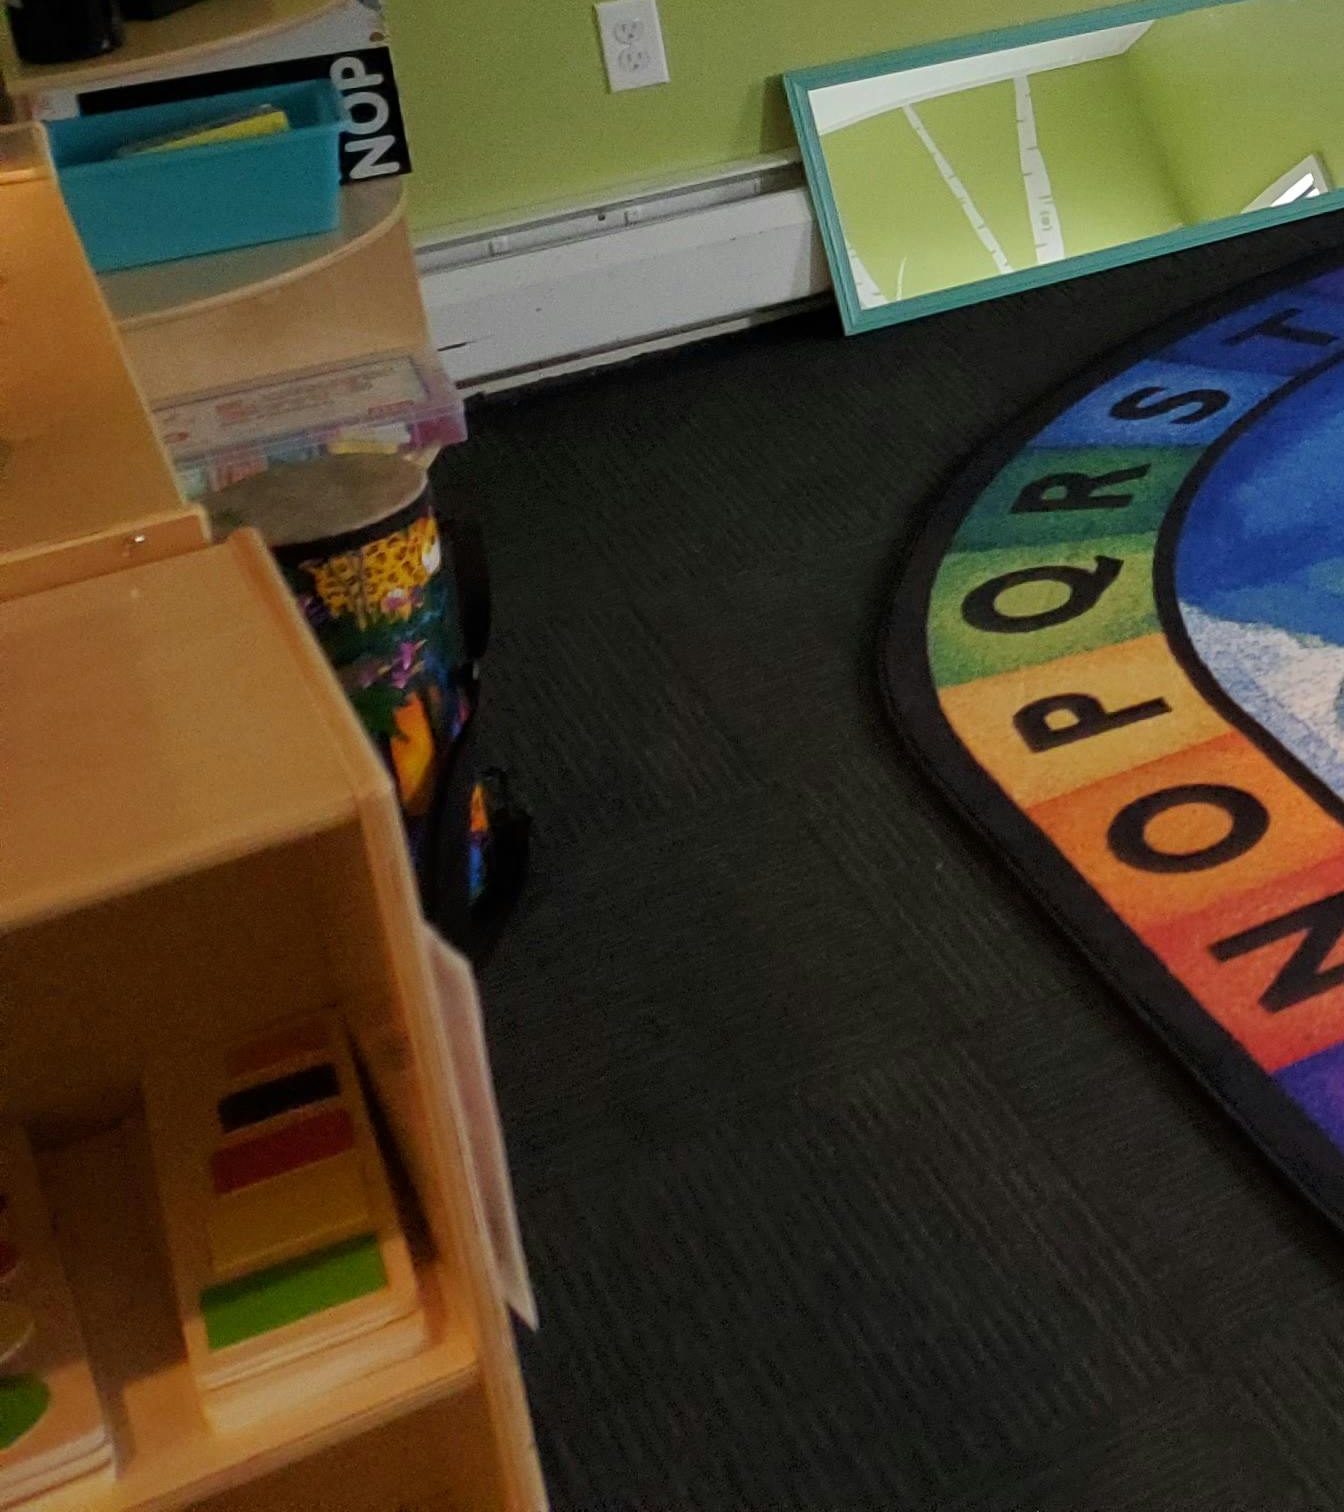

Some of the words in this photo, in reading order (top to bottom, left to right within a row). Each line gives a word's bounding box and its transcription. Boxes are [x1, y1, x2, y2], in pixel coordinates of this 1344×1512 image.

[329, 56, 401, 180] NOP
[1219, 308, 1341, 346] T
[1107, 386, 1232, 425] S
[1008, 462, 1152, 514] R
[960, 555, 1124, 634] Q
[1012, 692, 1173, 754] P
[1106, 783, 1270, 874] O
